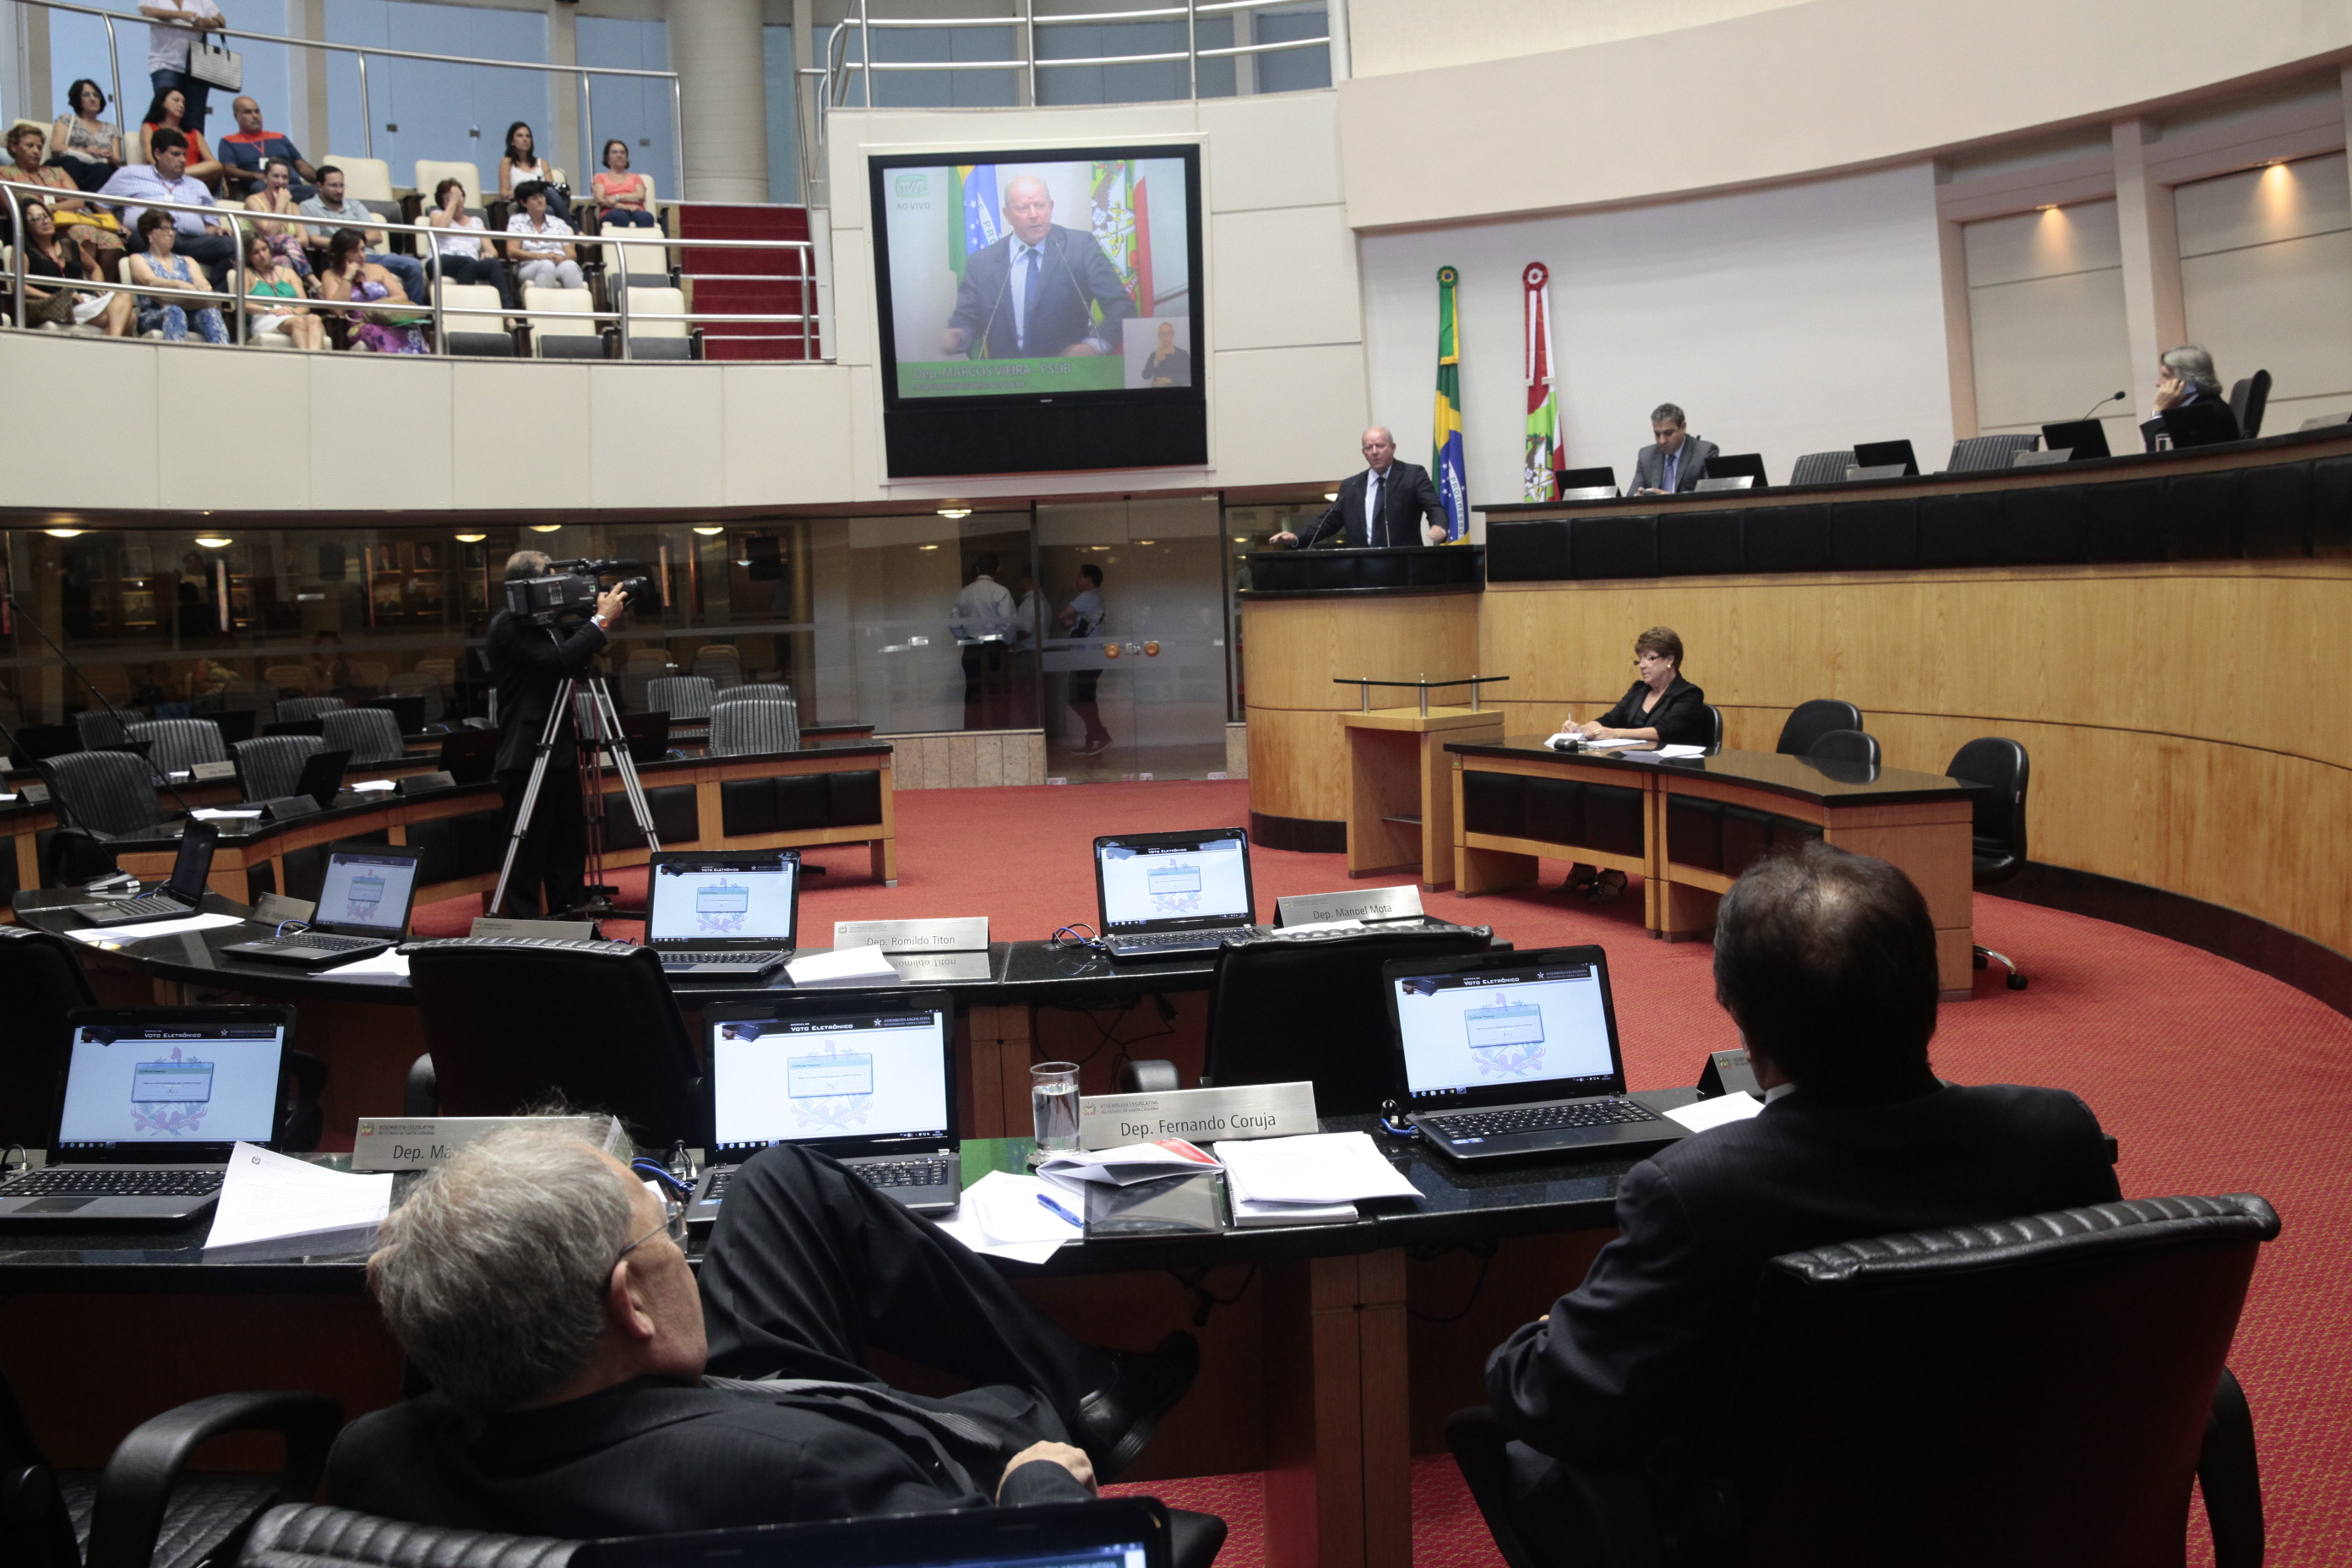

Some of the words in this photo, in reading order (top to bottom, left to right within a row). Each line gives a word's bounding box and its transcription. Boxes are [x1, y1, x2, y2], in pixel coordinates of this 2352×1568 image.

[910, 202, 931, 210] VIVO
[942, 364, 992, 378] MARCOS
[994, 363, 1032, 377] VIEIRA
[1041, 362, 1071, 375] PSDB
[1313, 911, 1333, 921] Dep.
[1336, 905, 1368, 917] Manoel
[1369, 903, 1392, 914] Mota
[867, 938, 888, 946] Dep.
[891, 936, 929, 946] Romildo
[932, 935, 956, 945] Titon
[1120, 1122, 1153, 1139] Dep.
[1158, 1115, 1225, 1134] Fernando
[1230, 1113, 1277, 1130] Coruja
[393, 1145, 424, 1163] Dep.
[430, 1145, 452, 1159] Ma
